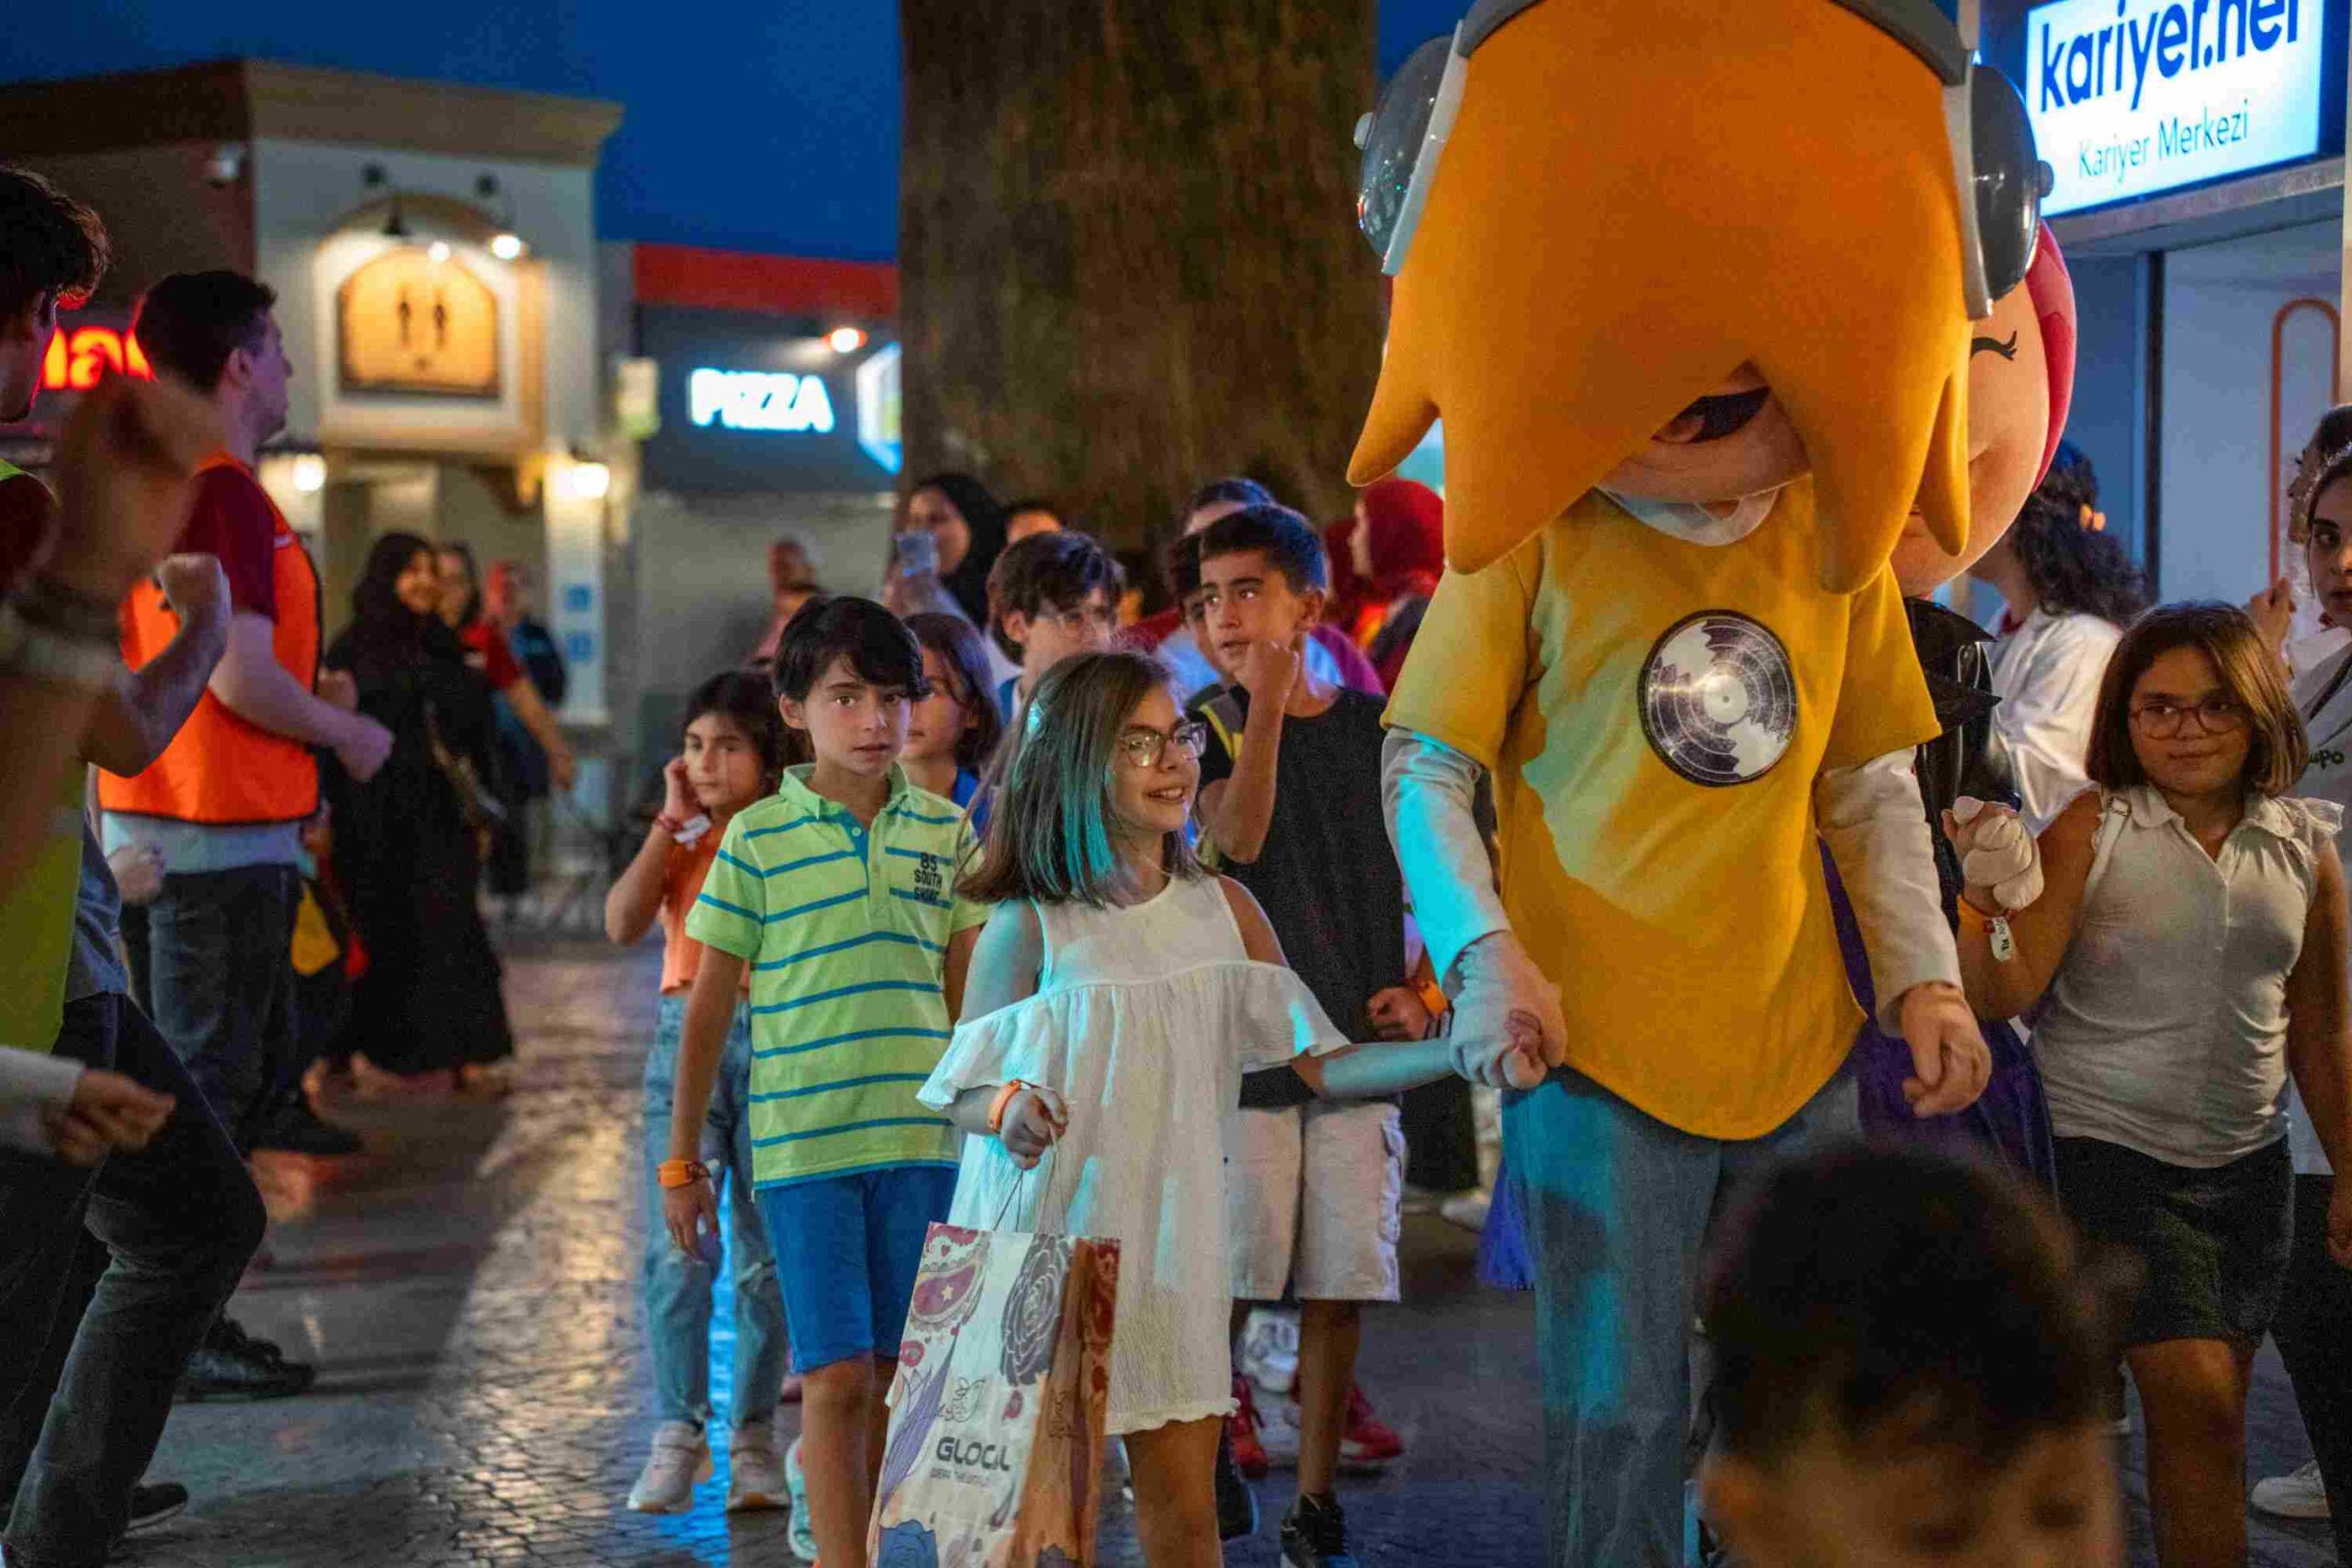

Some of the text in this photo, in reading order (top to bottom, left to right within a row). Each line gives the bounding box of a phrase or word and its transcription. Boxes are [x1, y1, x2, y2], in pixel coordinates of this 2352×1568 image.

[2078, 97, 2249, 183] Kariyer Merkezi
[691, 368, 834, 433] PIZZA
[914, 869, 942, 889] SOUTH
